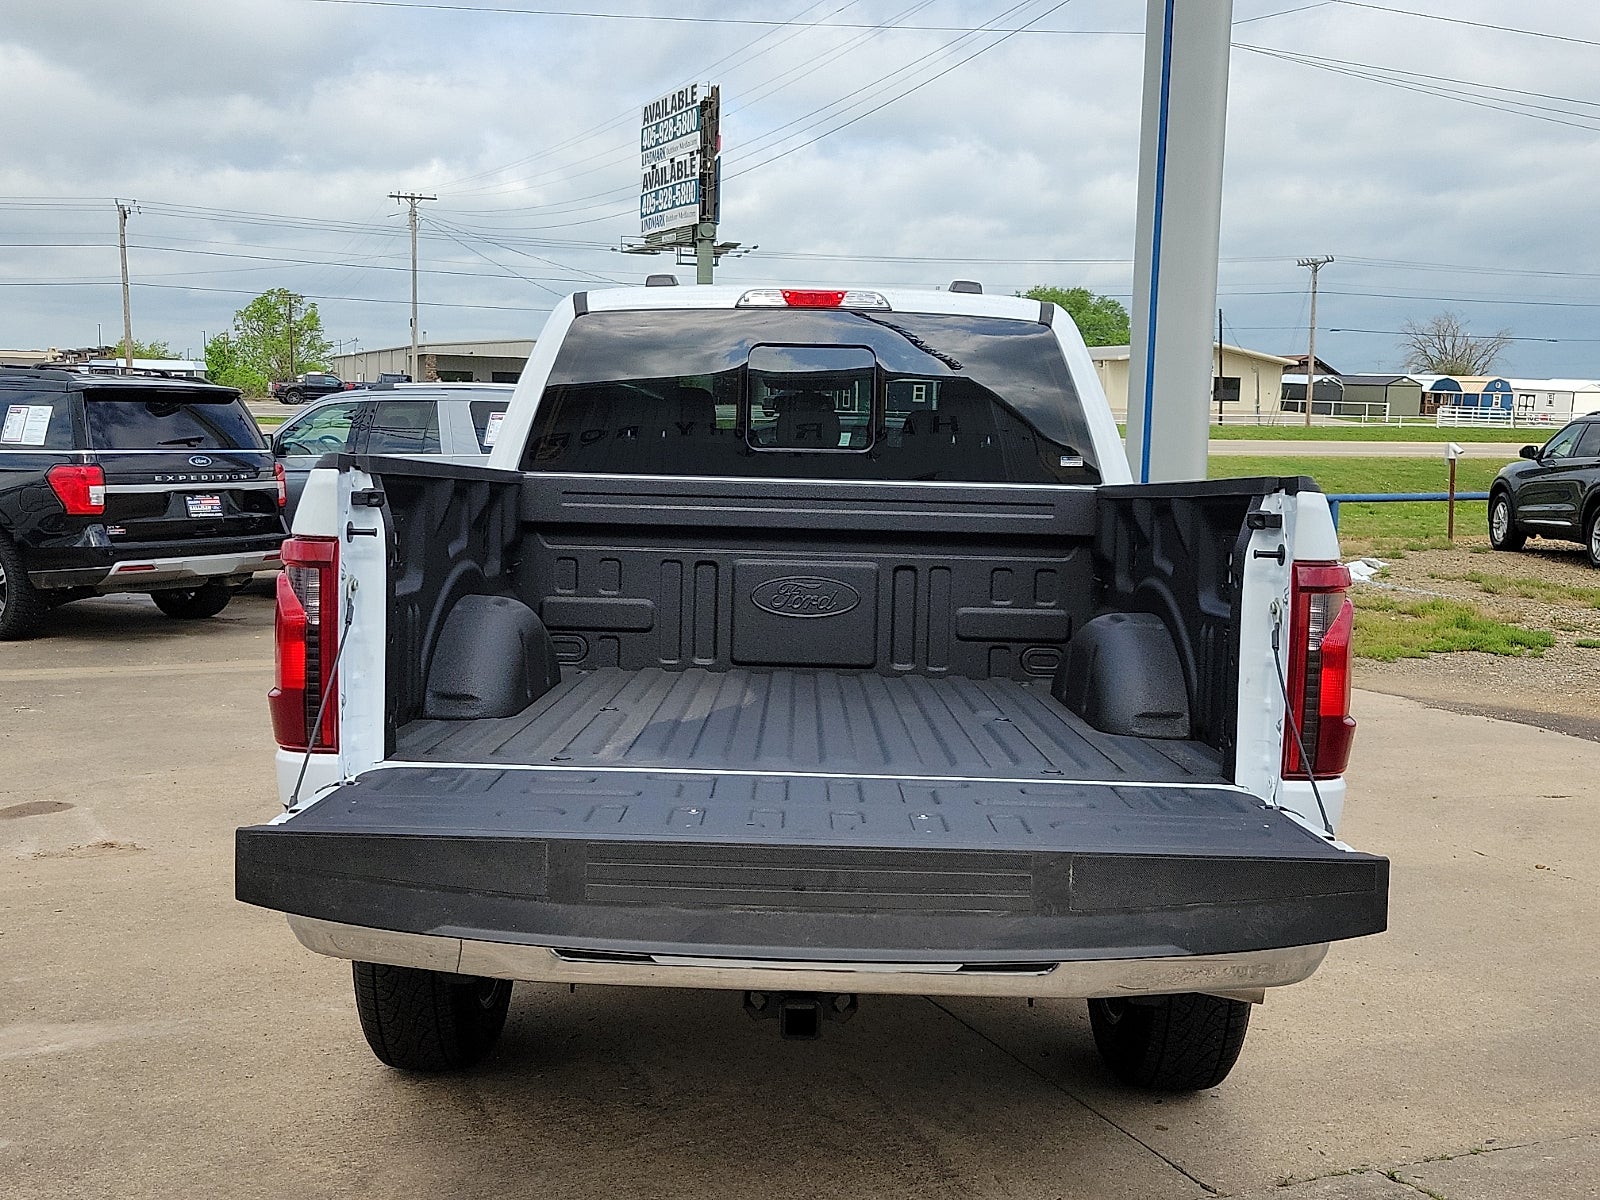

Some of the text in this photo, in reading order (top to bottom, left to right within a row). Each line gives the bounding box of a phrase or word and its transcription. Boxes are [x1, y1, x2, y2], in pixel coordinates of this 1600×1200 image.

[643, 83, 698, 126] AVAILABLE
[642, 108, 698, 150] 405-928-5800
[641, 156, 697, 193] AVAILABLE
[641, 180, 696, 216] 405-928-5800
[771, 580, 839, 610] Ford
